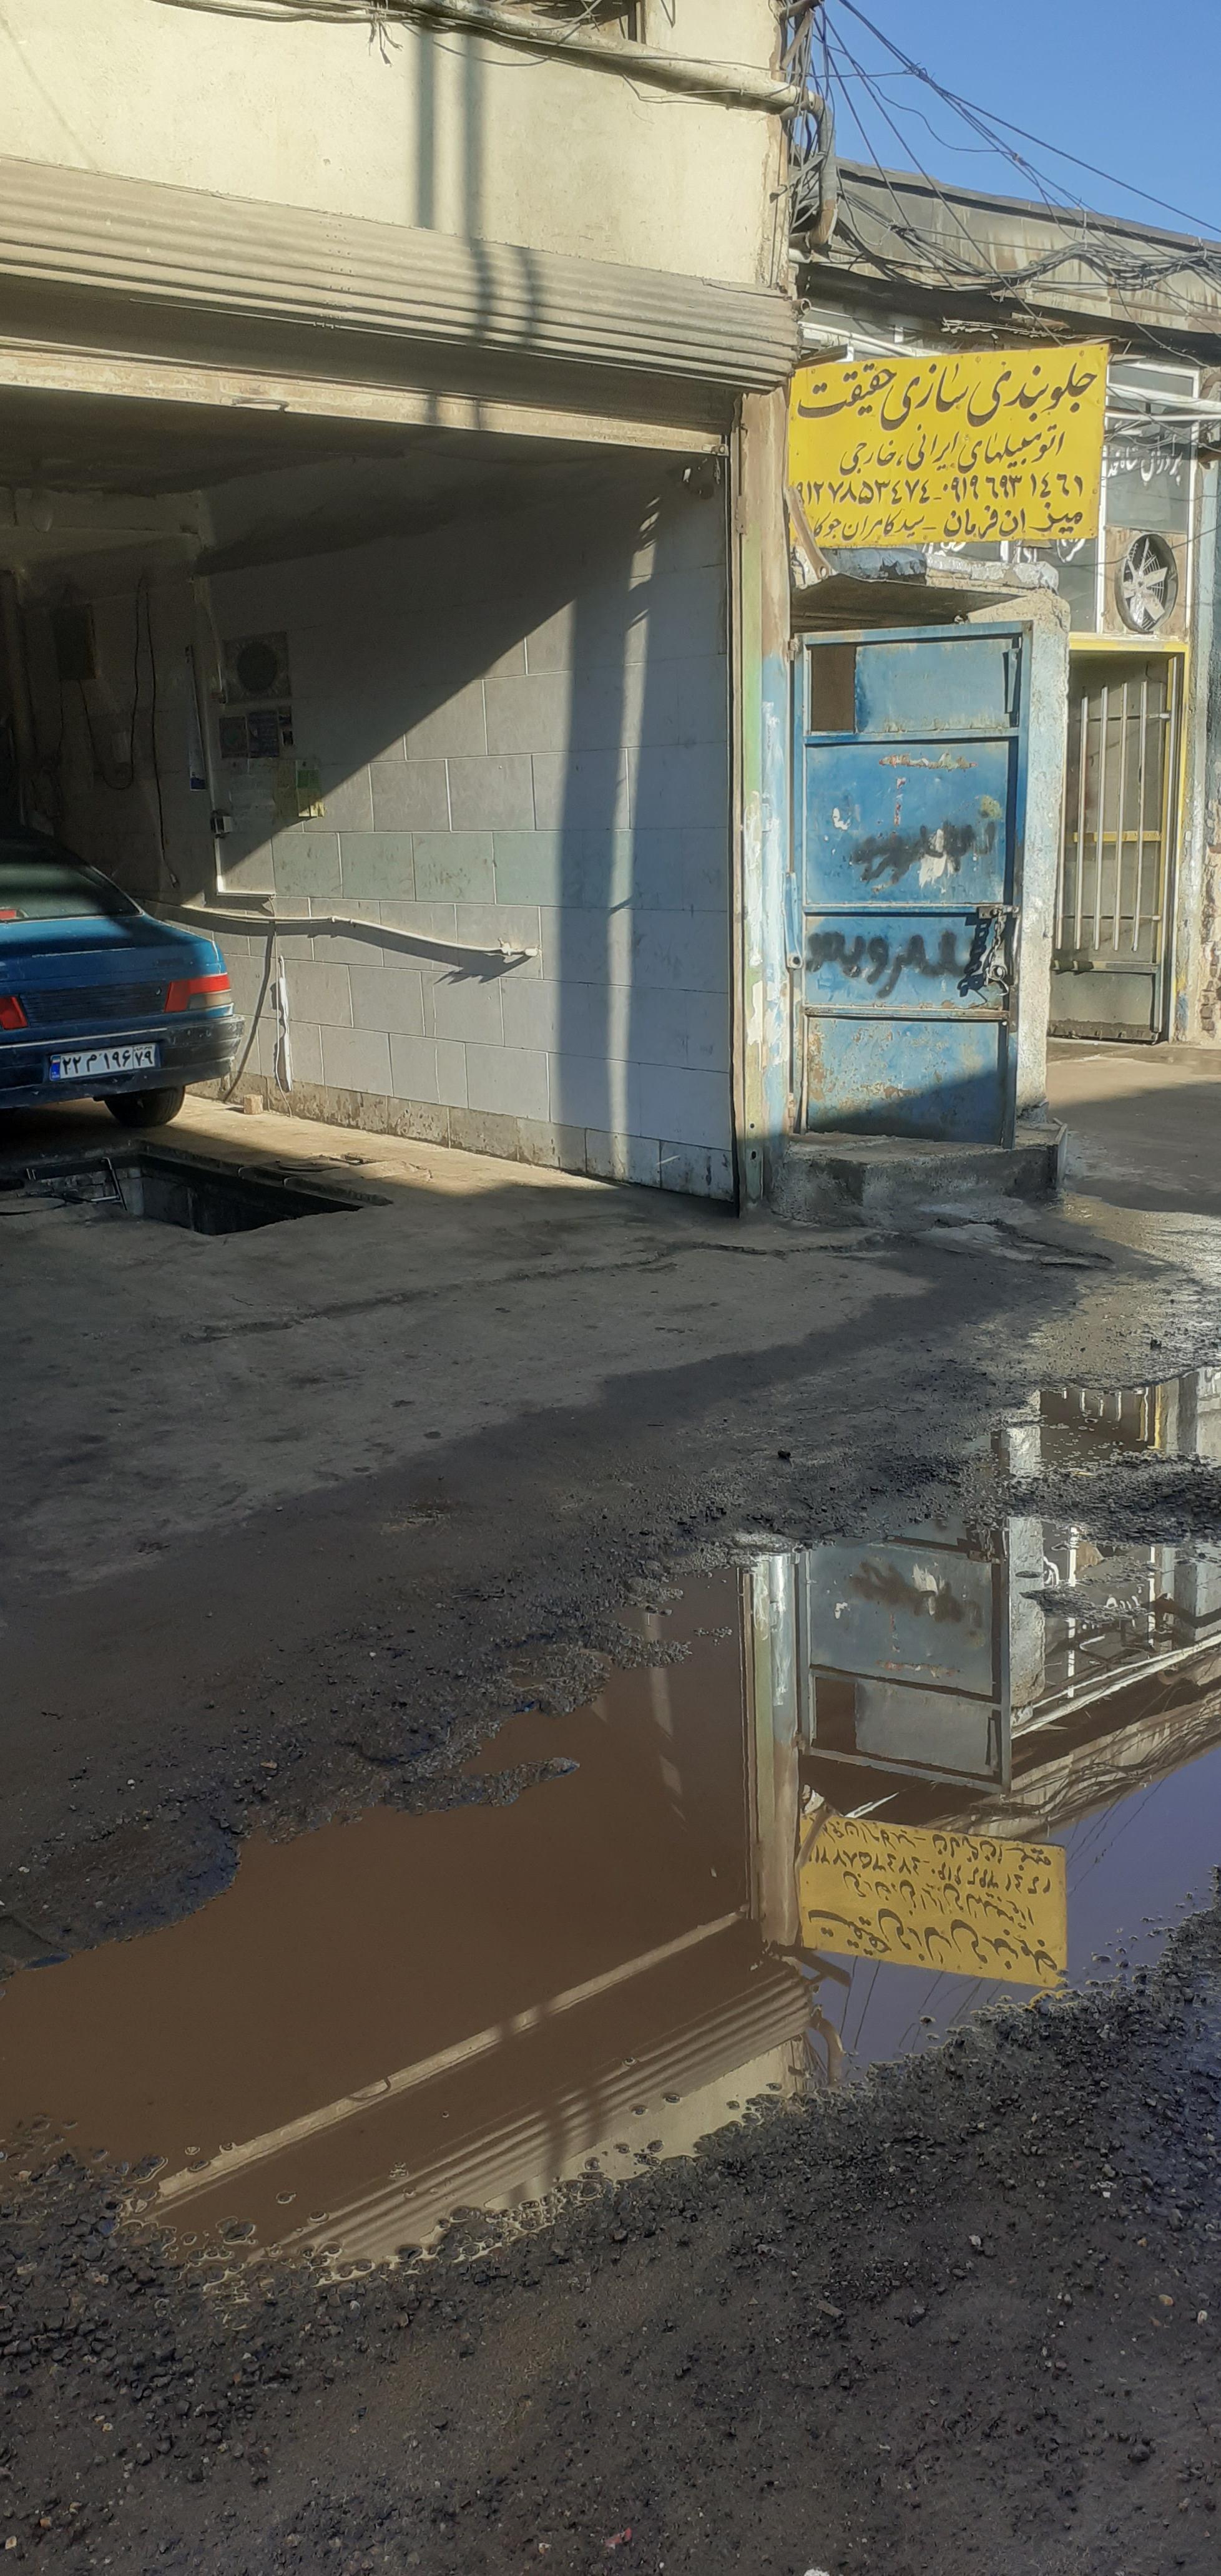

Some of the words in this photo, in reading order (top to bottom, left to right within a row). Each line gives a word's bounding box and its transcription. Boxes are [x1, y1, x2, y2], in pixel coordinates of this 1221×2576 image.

[797, 363, 897, 419] حقیقت
[880, 363, 969, 431] سازی
[967, 362, 1098, 427] جلوبندی
[839, 439, 896, 476] خارجی
[796, 479, 931, 505] ۹۱۲۷۸۵۳۴۷۴
[841, 509, 903, 541] کامران
[894, 515, 925, 538] سید
[135, 1050, 154, 1067] ۷۹
